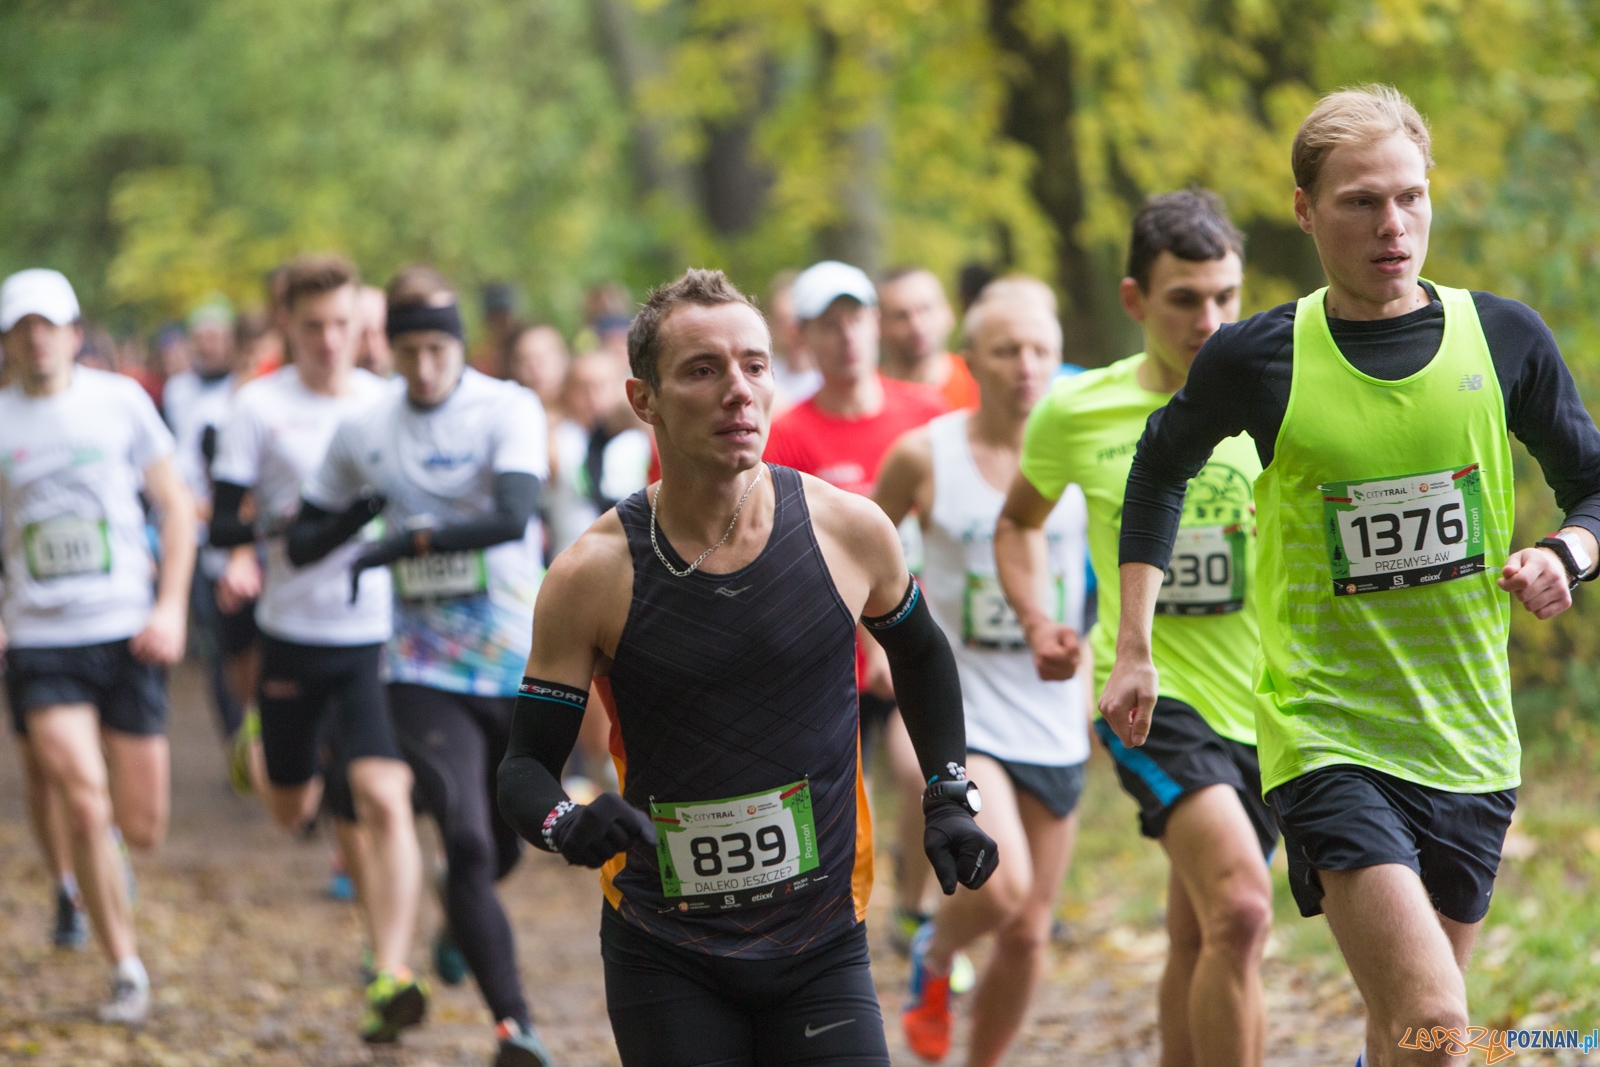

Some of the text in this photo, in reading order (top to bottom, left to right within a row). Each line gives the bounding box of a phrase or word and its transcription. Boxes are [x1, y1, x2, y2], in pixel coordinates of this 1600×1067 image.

[1351, 503, 1463, 558] 1376
[1470, 507, 1480, 543] Poznań
[1375, 551, 1450, 571] PRZEMYSŁAW
[690, 825, 786, 876] 839
[801, 823, 813, 859] Poznań
[695, 878, 739, 893] DALEKO
[742, 866, 792, 888] JESZCZE?
